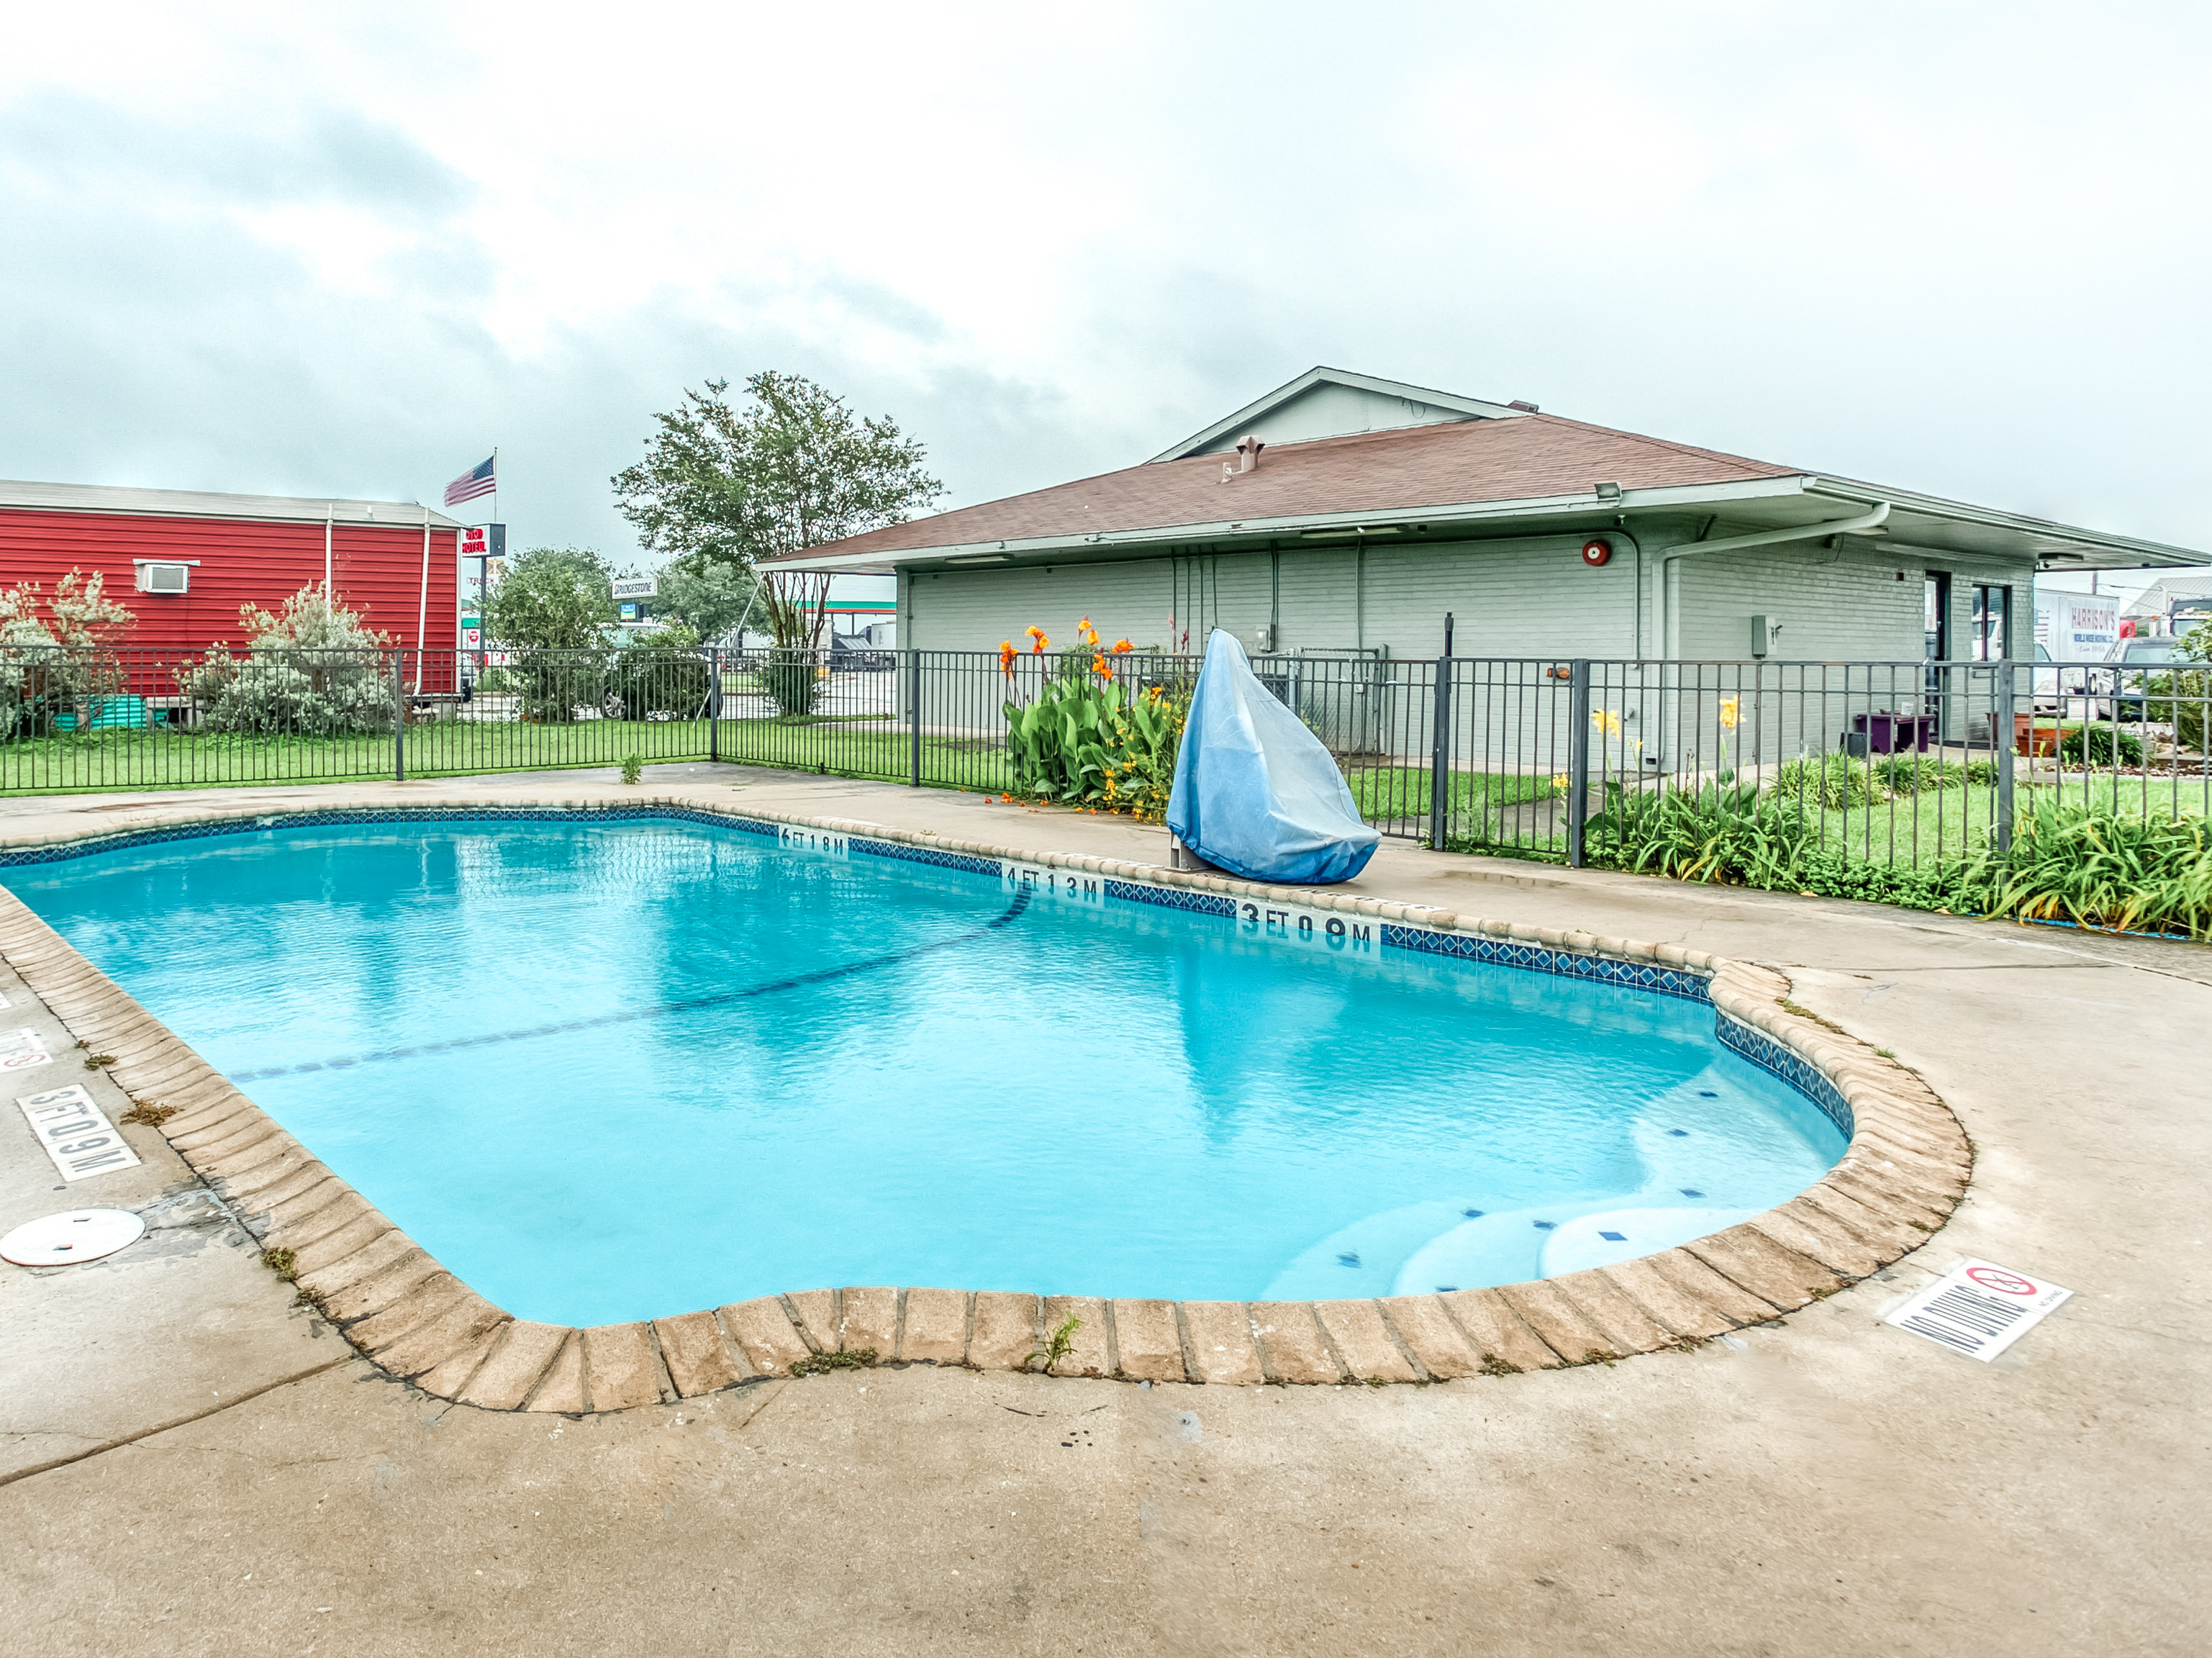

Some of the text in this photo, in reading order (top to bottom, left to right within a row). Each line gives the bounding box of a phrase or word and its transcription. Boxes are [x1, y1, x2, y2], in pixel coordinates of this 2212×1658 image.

[615, 582, 652, 594] BRIDGESTONE
[2072, 607, 2115, 630] HARRISON'S
[1900, 1285, 2029, 1353] NO DIVING
